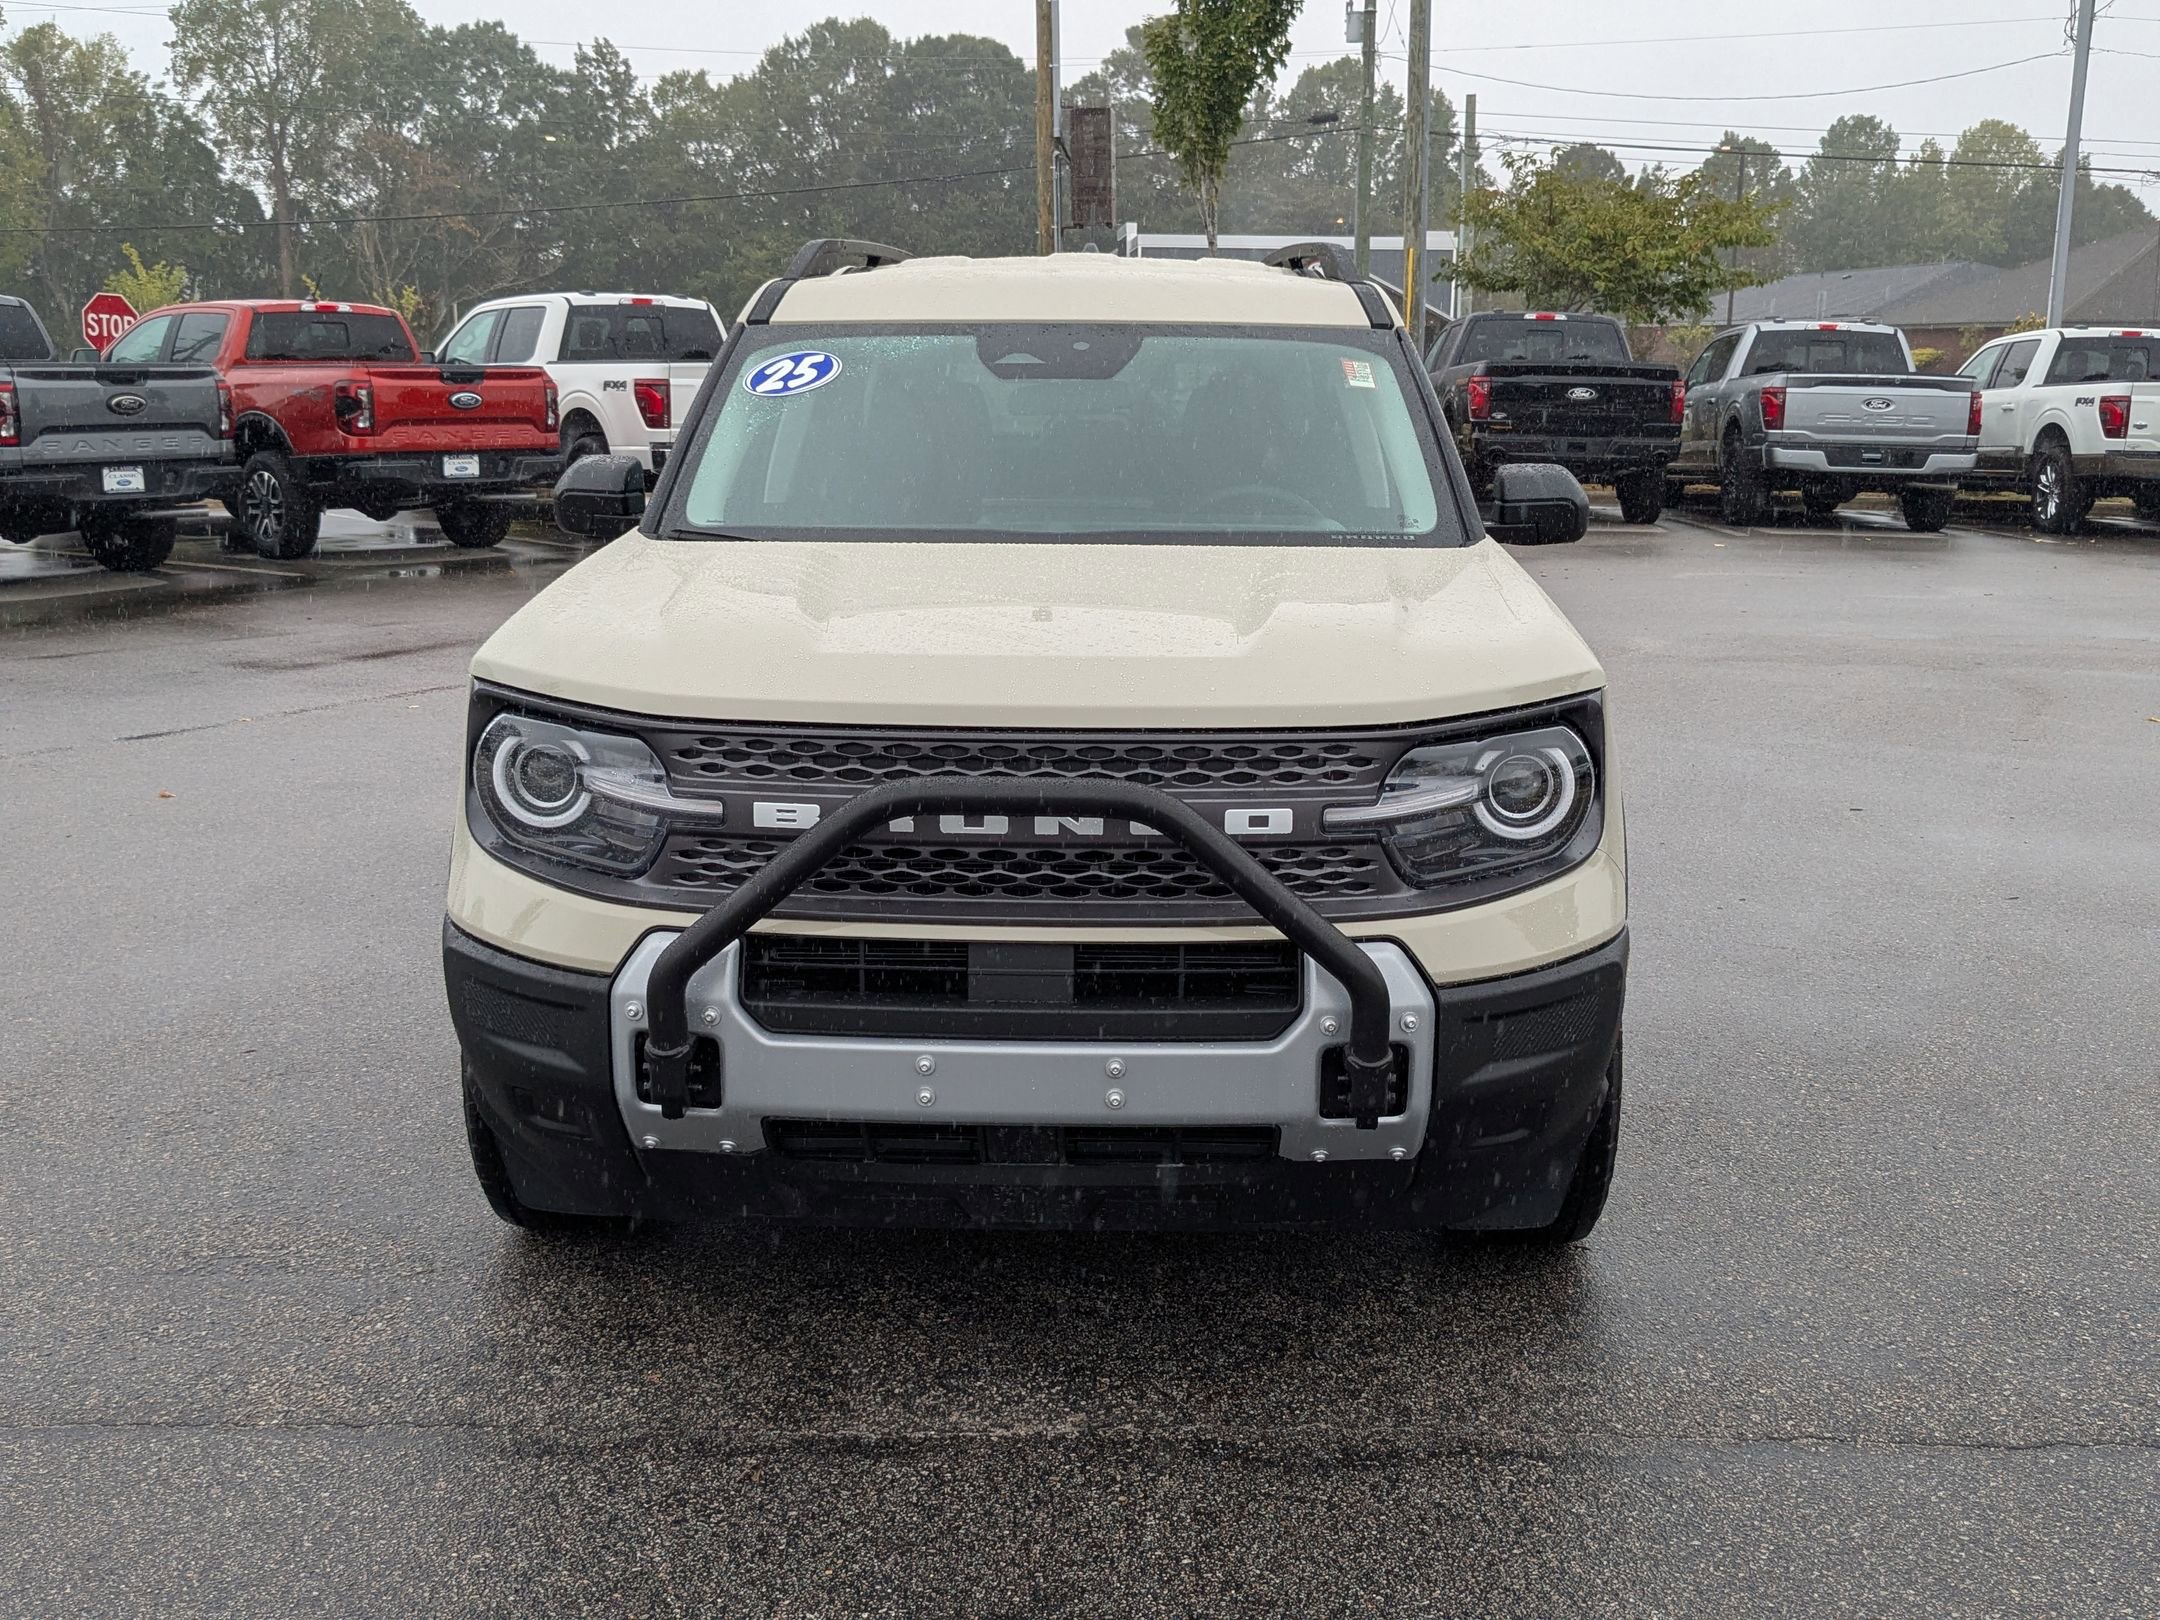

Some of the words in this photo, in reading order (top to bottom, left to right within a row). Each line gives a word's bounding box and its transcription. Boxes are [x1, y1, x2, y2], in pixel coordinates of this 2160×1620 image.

[87, 312, 137, 337] STOP
[755, 354, 826, 393] 25
[603, 380, 627, 391] FX4
[1868, 399, 1888, 409] Ford
[2074, 397, 2095, 407] FX4
[753, 802, 1293, 836] BONO
